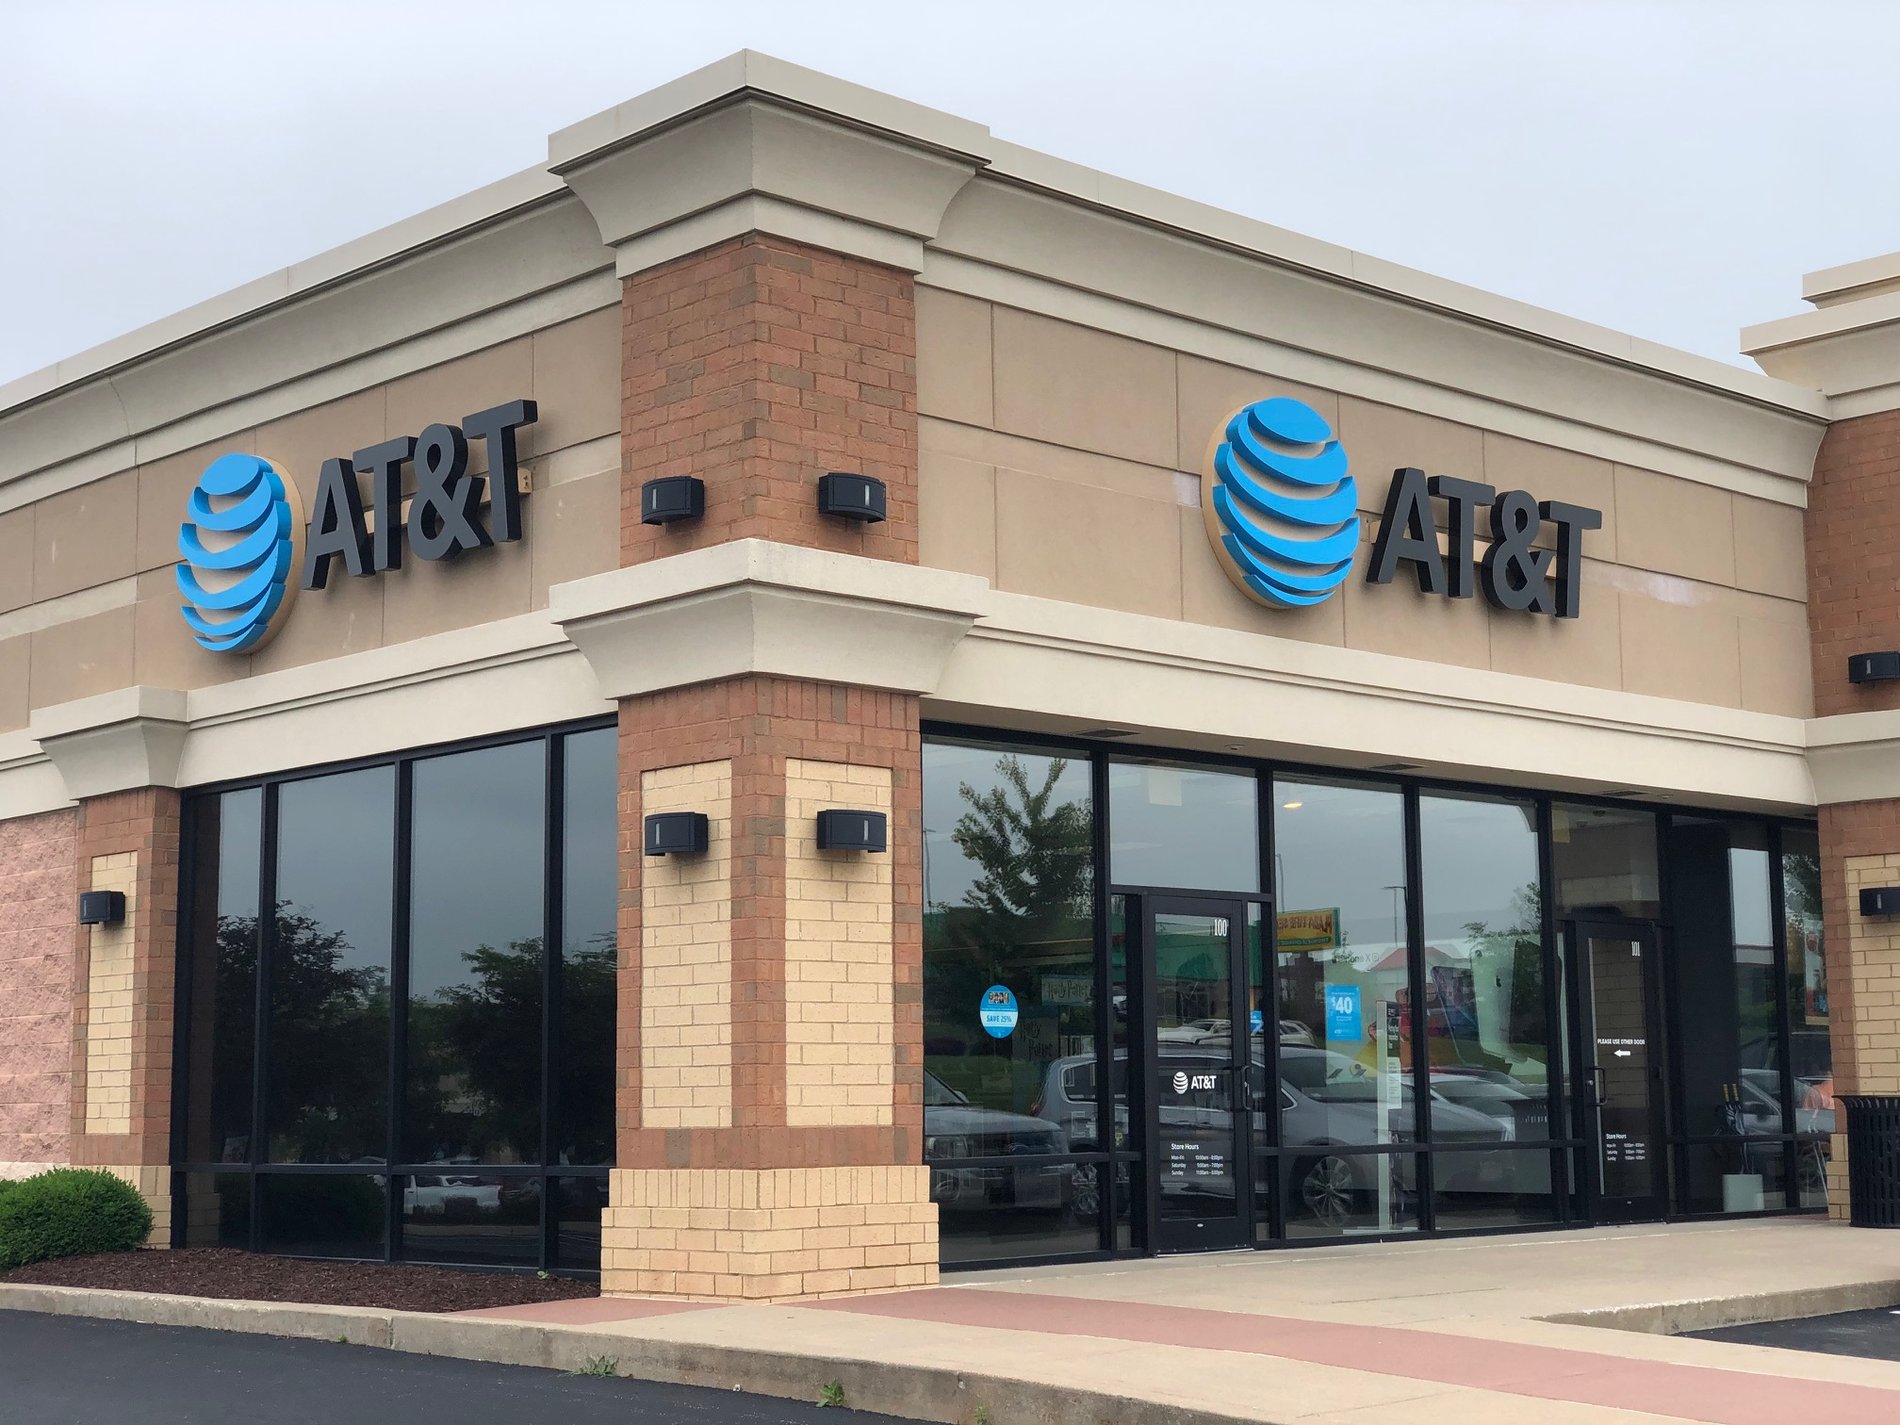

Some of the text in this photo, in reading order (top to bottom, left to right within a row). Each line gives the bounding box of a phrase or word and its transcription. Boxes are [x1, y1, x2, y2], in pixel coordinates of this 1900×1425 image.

[301, 399, 538, 590] AT&T
[1366, 467, 1602, 619] AT&T
[1214, 918, 1227, 937] 100
[1332, 996, 1353, 1014] $40
[1190, 1075, 1217, 1090] AT&T
